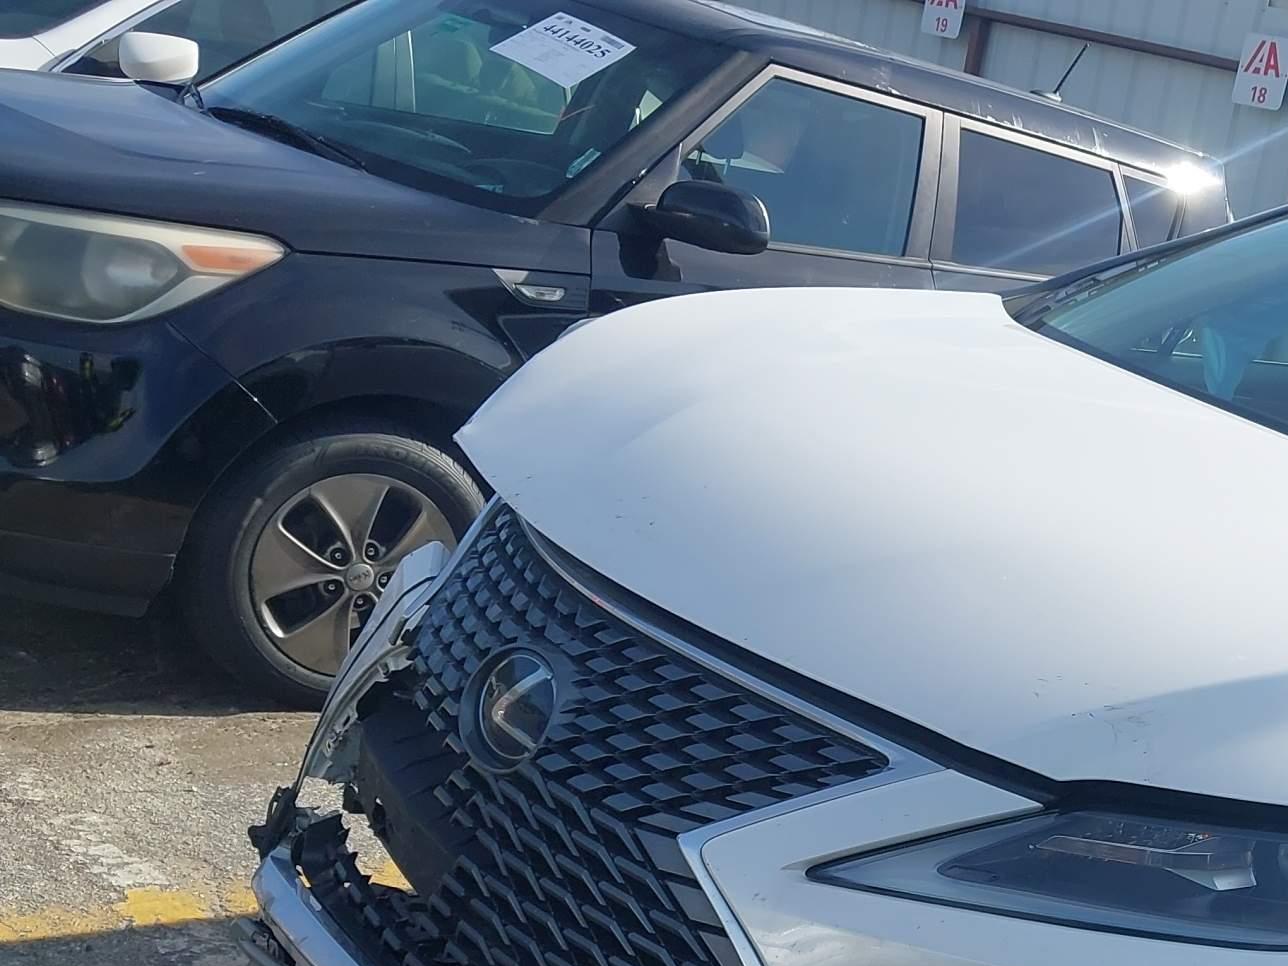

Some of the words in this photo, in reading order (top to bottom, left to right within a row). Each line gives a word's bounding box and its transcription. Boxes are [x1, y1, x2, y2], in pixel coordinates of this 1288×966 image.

[935, 16, 949, 33] 19
[543, 24, 612, 59] 44144025
[1251, 86, 1267, 104] 18
